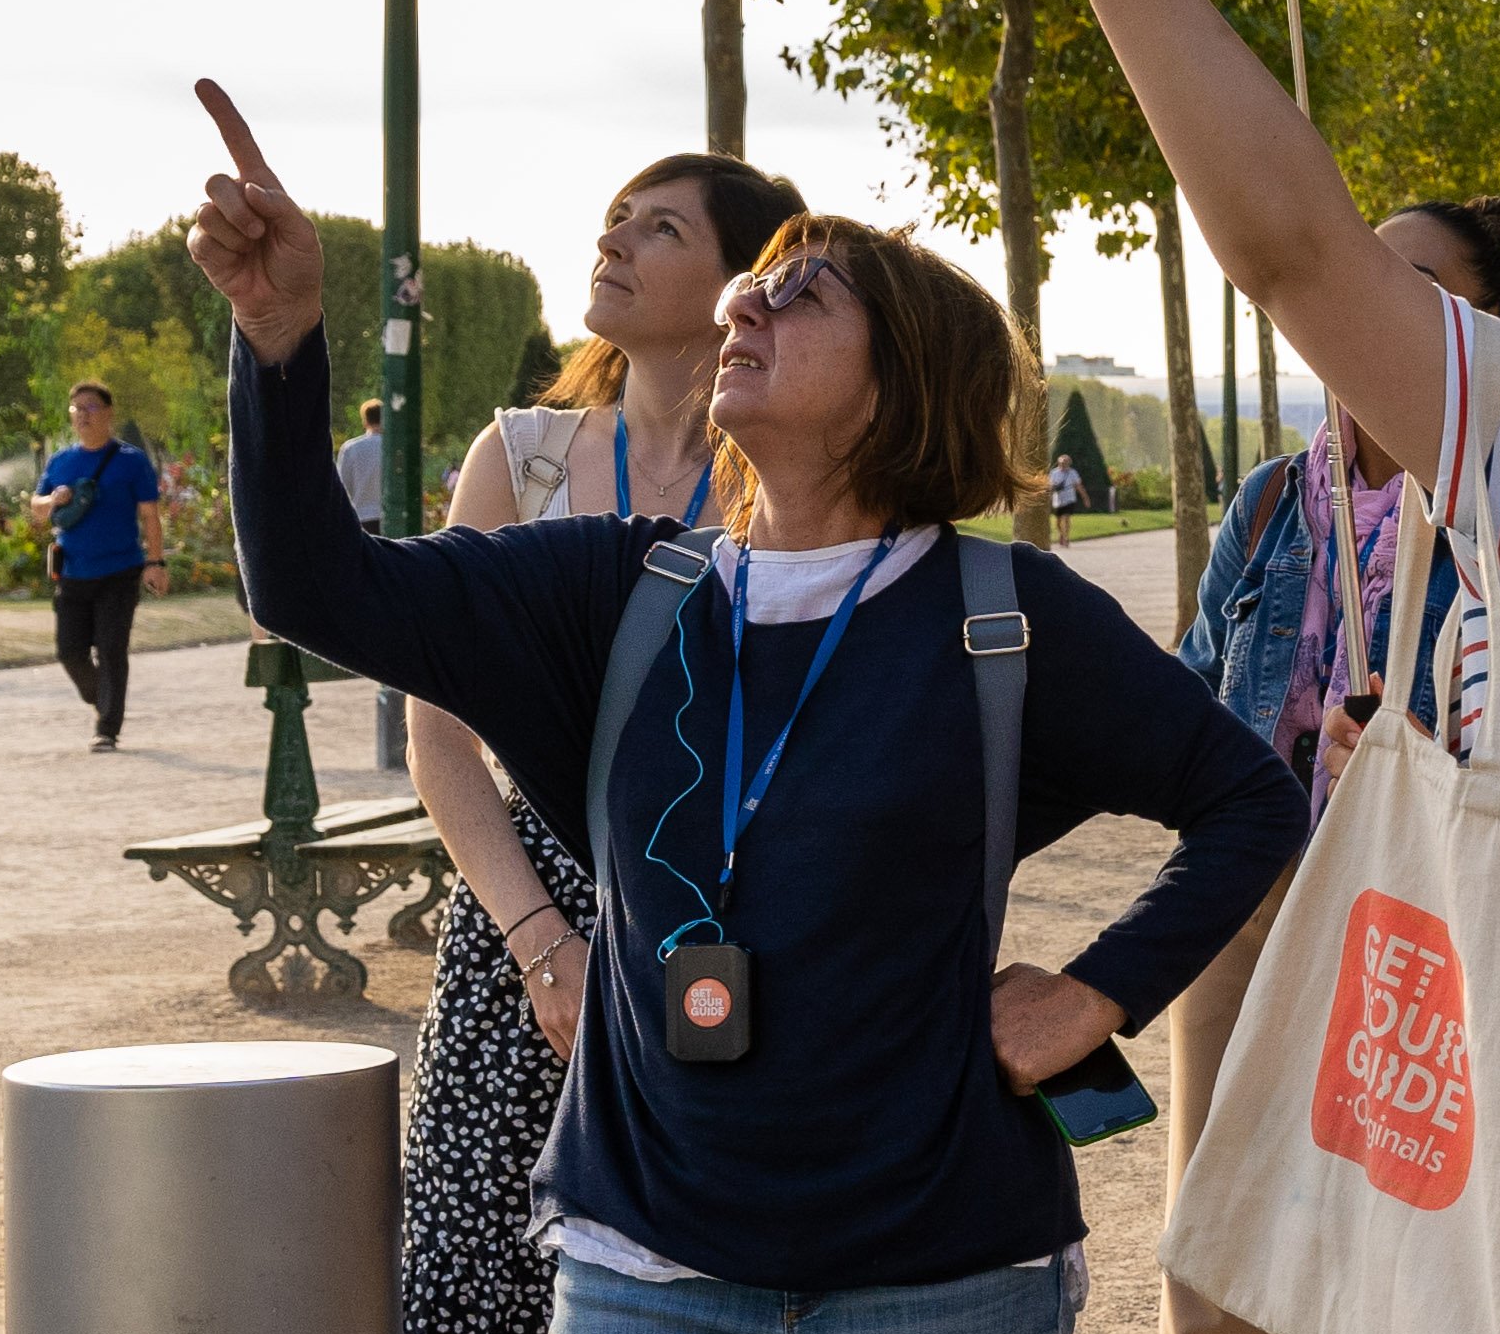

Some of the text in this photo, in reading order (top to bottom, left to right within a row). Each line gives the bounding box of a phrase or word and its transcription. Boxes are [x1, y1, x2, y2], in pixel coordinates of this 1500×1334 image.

[1364, 923, 1446, 1000] GET
[690, 988, 713, 998] GET
[690, 997, 724, 1008] YOUR
[690, 1007, 726, 1017] GUIDE
[1361, 974, 1466, 1077] YOUR
[1346, 1029, 1467, 1134] GUIDE
